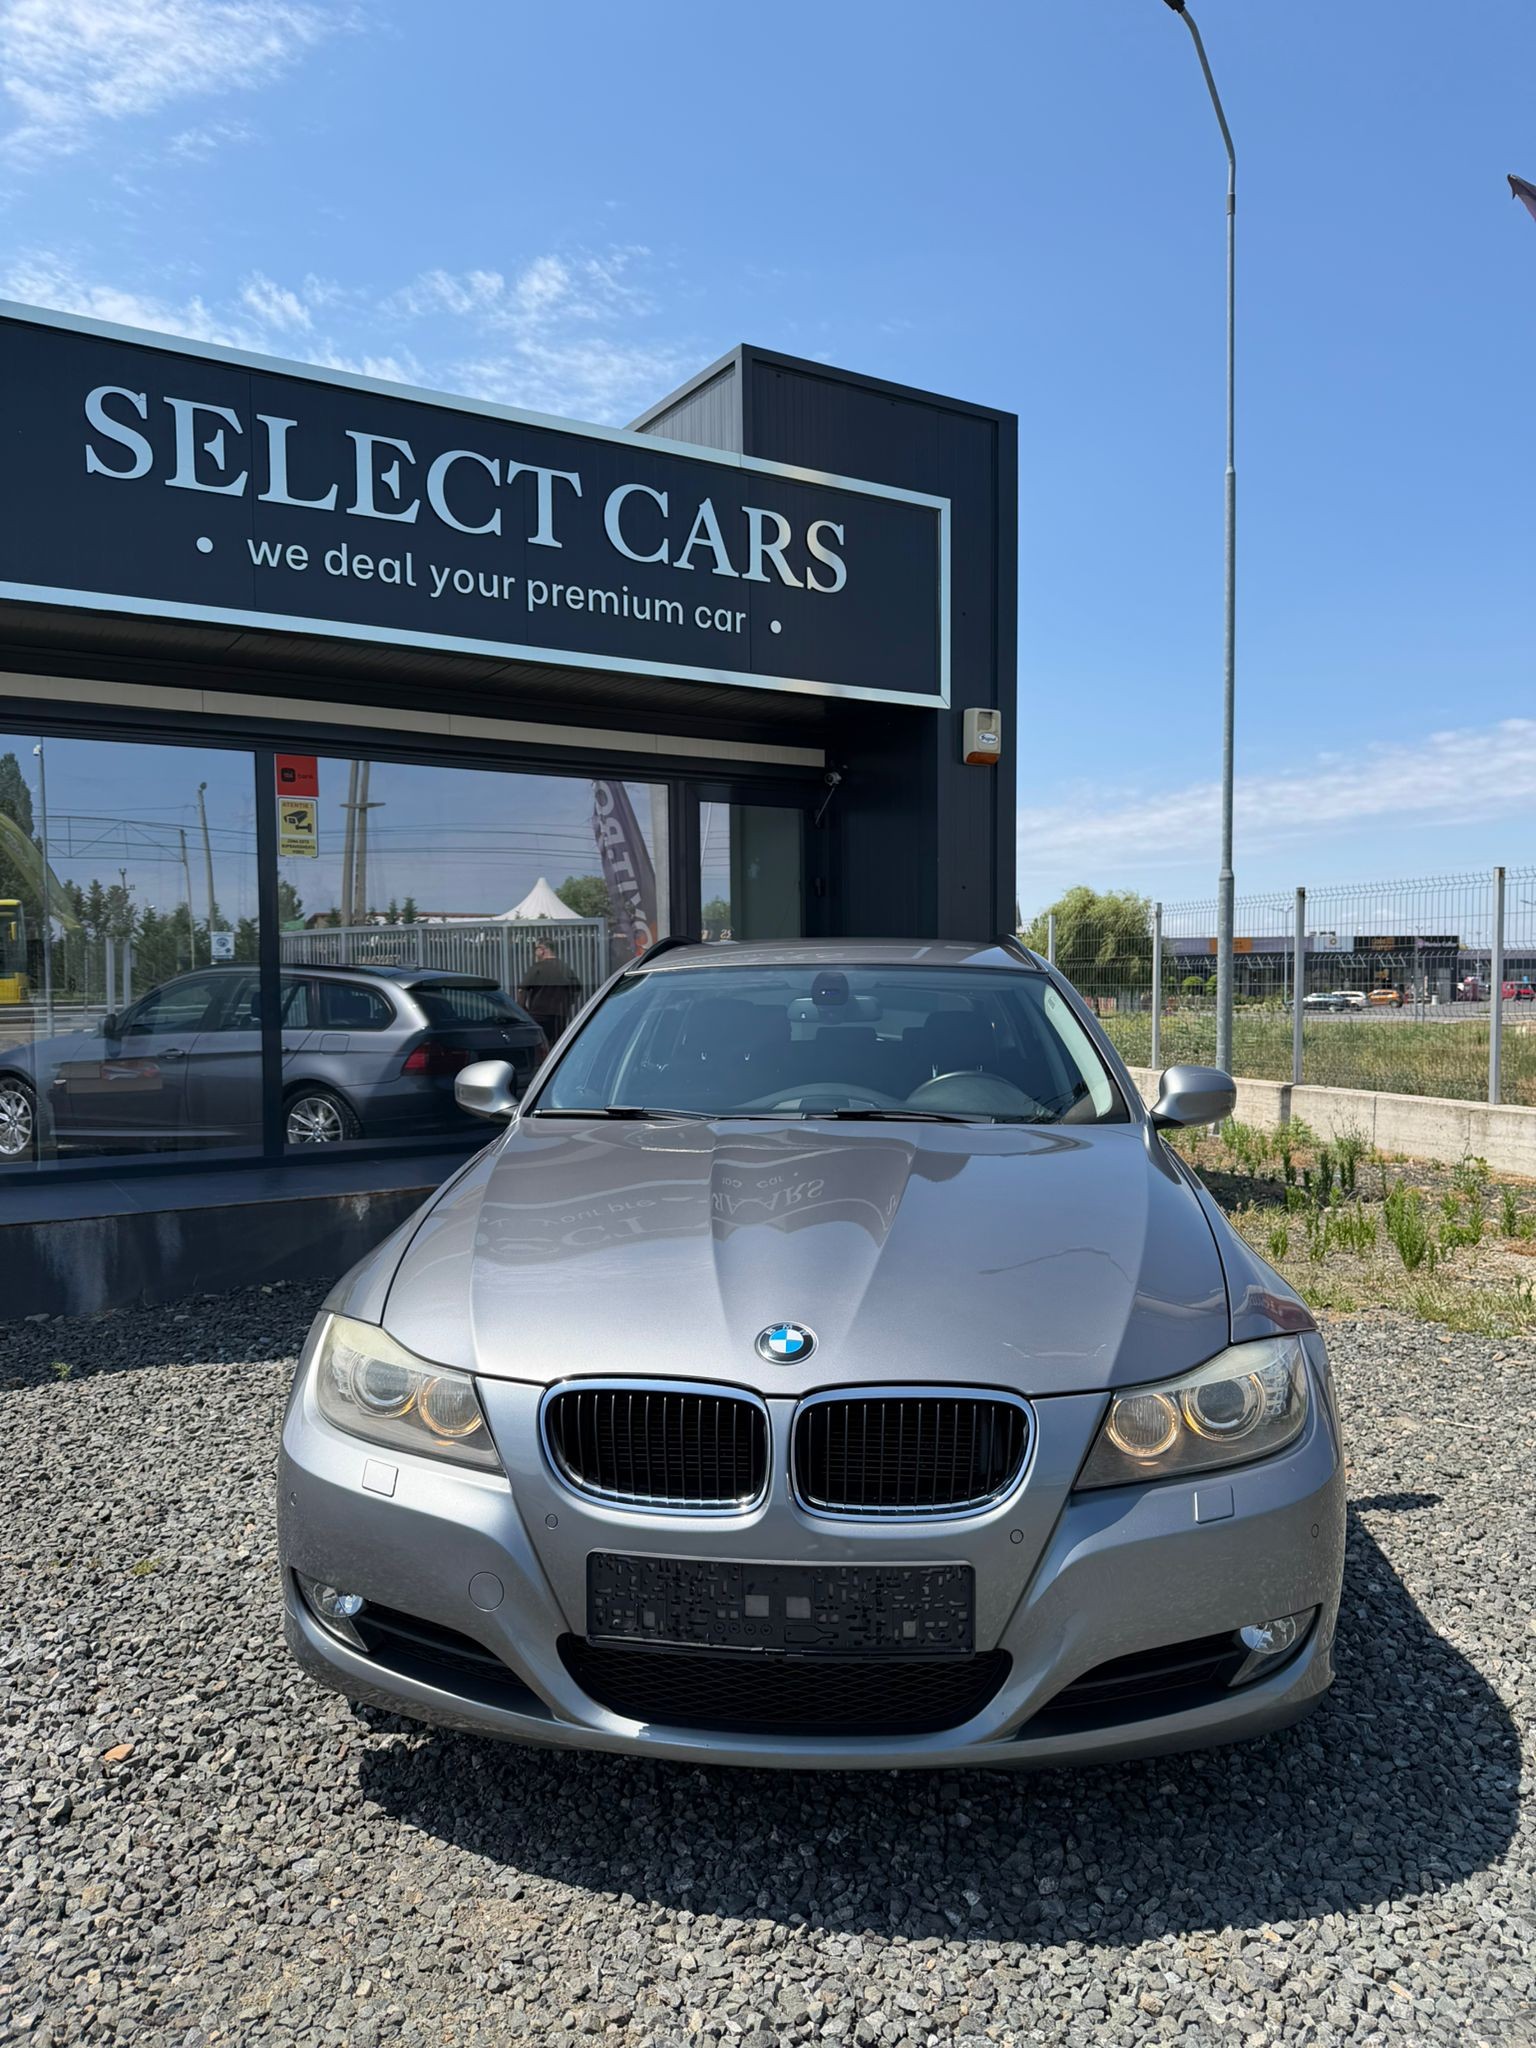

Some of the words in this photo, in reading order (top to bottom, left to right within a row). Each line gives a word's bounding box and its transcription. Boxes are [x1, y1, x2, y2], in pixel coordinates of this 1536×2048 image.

[84, 385, 583, 550] SELECT
[604, 484, 848, 594] CARS
[247, 538, 309, 571] we
[324, 542, 417, 588] deal
[429, 564, 516, 601] your
[527, 579, 684, 625] premium
[694, 606, 747, 634] car
